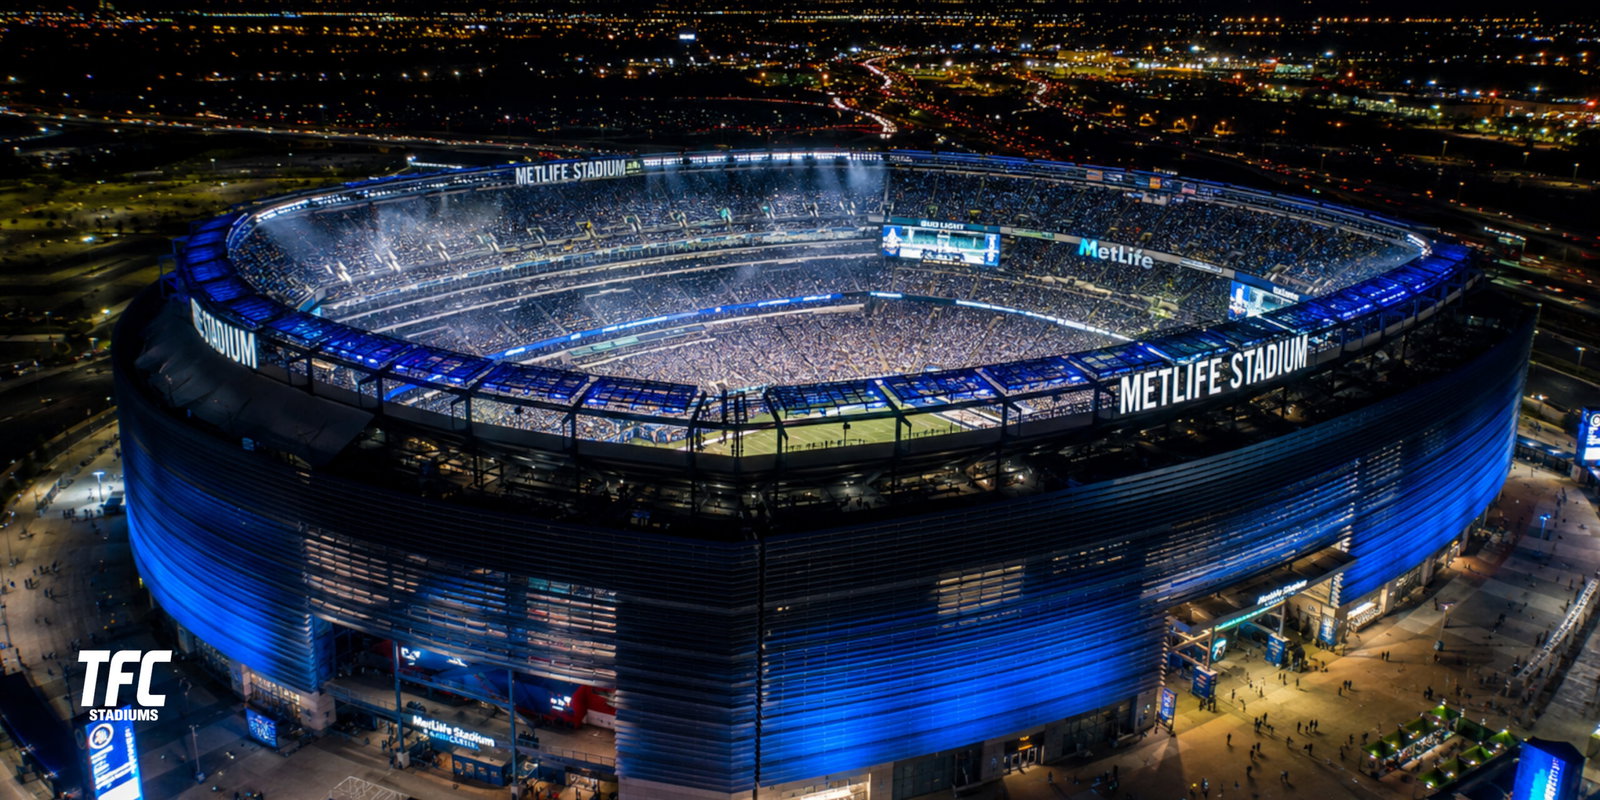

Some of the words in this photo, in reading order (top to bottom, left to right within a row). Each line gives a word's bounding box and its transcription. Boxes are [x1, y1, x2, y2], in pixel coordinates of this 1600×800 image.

[515, 163, 569, 185] METLIFE
[573, 159, 626, 180] STADIUM
[1078, 237, 1154, 269] MetLife
[202, 310, 257, 369] STADIUM
[1120, 357, 1222, 415] METLIFE
[1230, 334, 1308, 389] STADIUM
